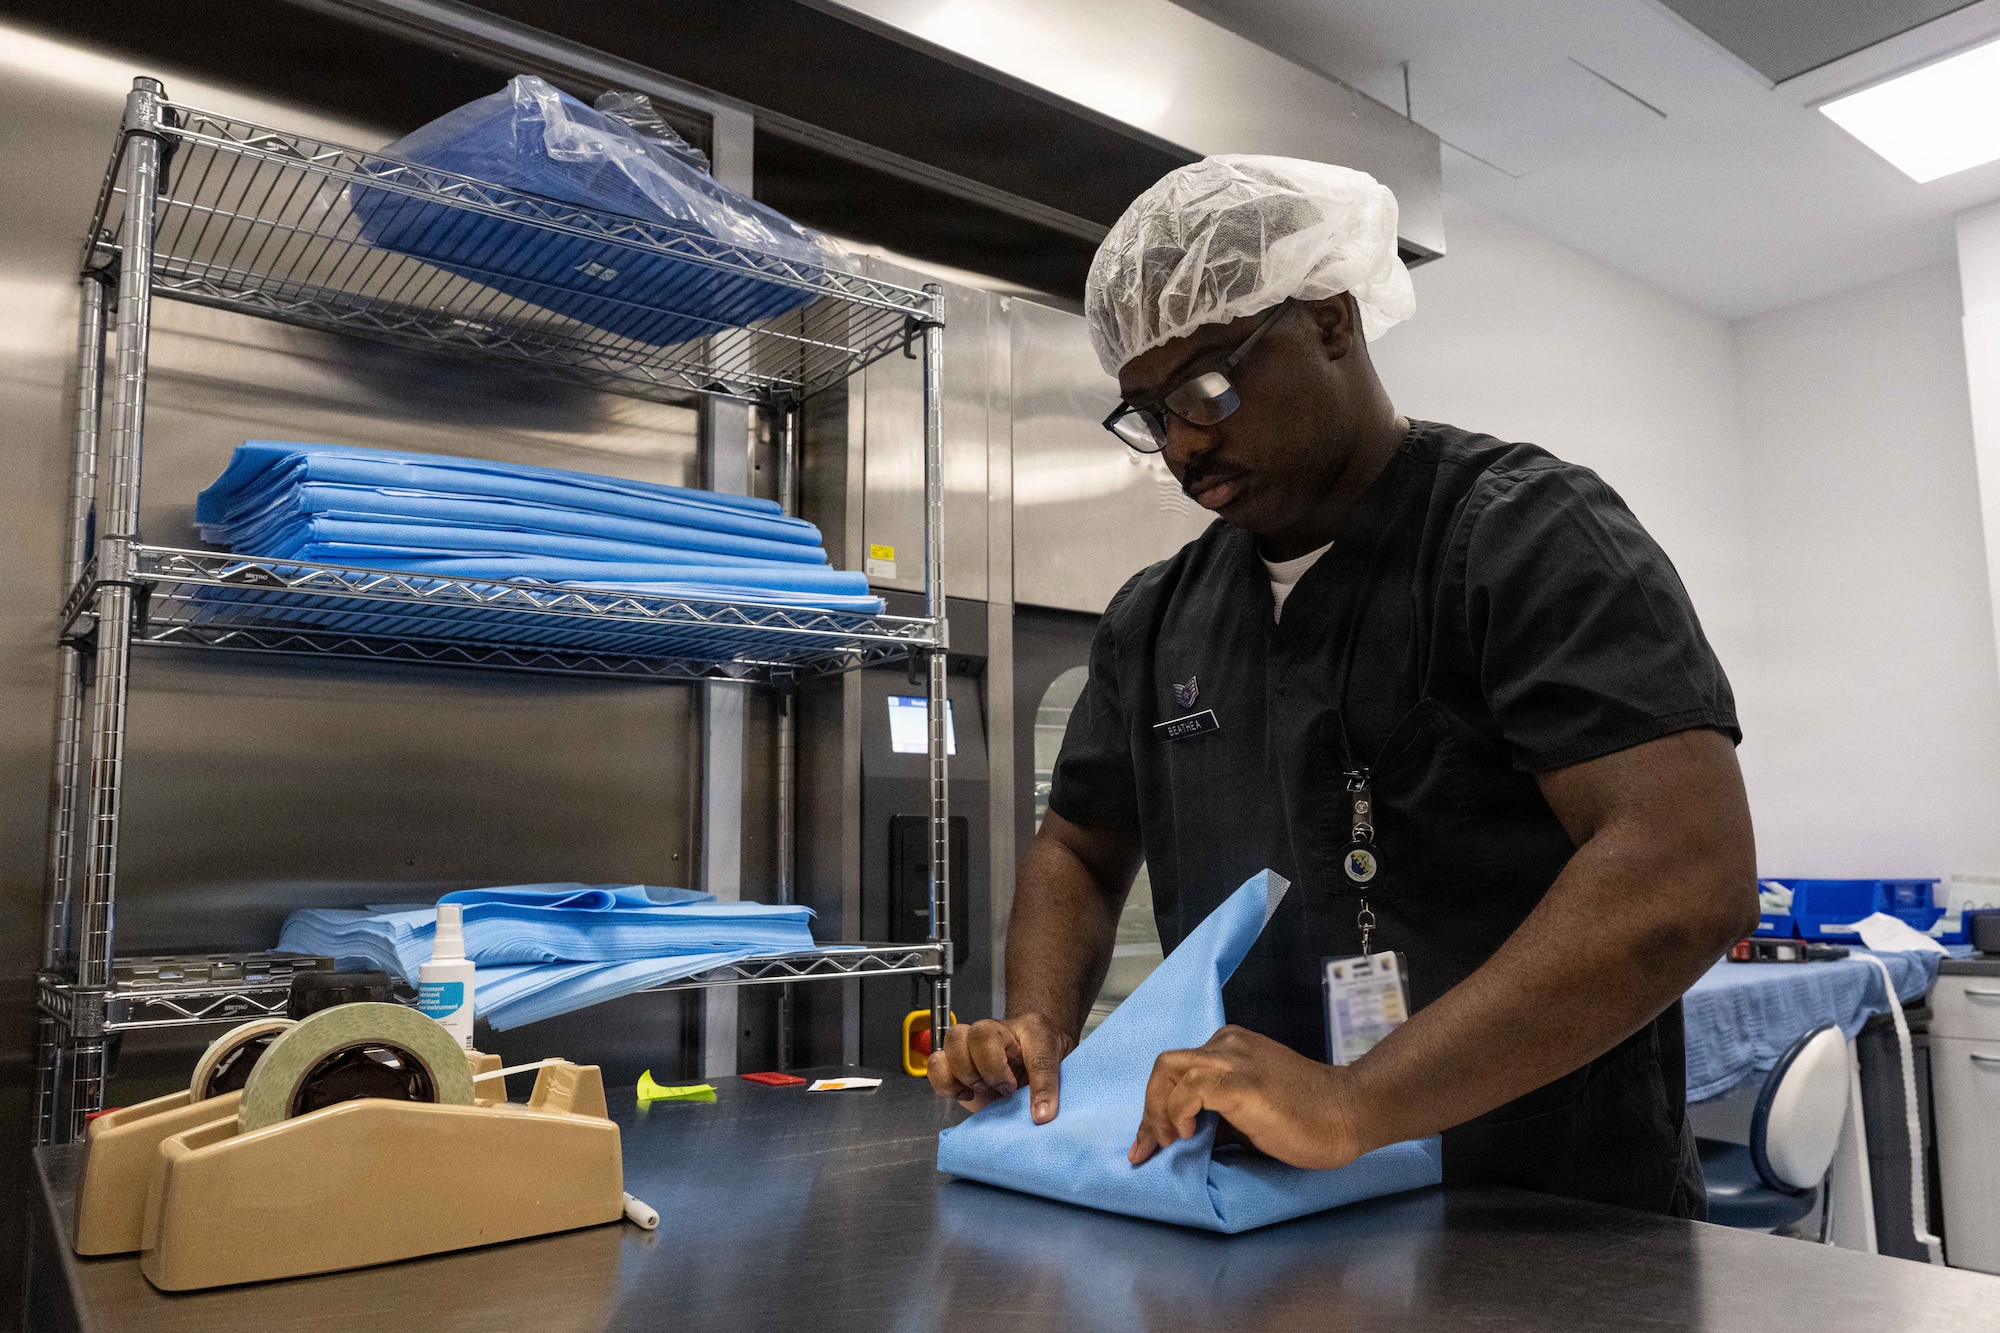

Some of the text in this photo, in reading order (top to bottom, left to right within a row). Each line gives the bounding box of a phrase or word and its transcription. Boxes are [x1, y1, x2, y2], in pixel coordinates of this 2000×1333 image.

[244, 572, 269, 582] METRO
[1167, 720, 1202, 737] BEATHEA
[223, 1004, 248, 1013] METRO
